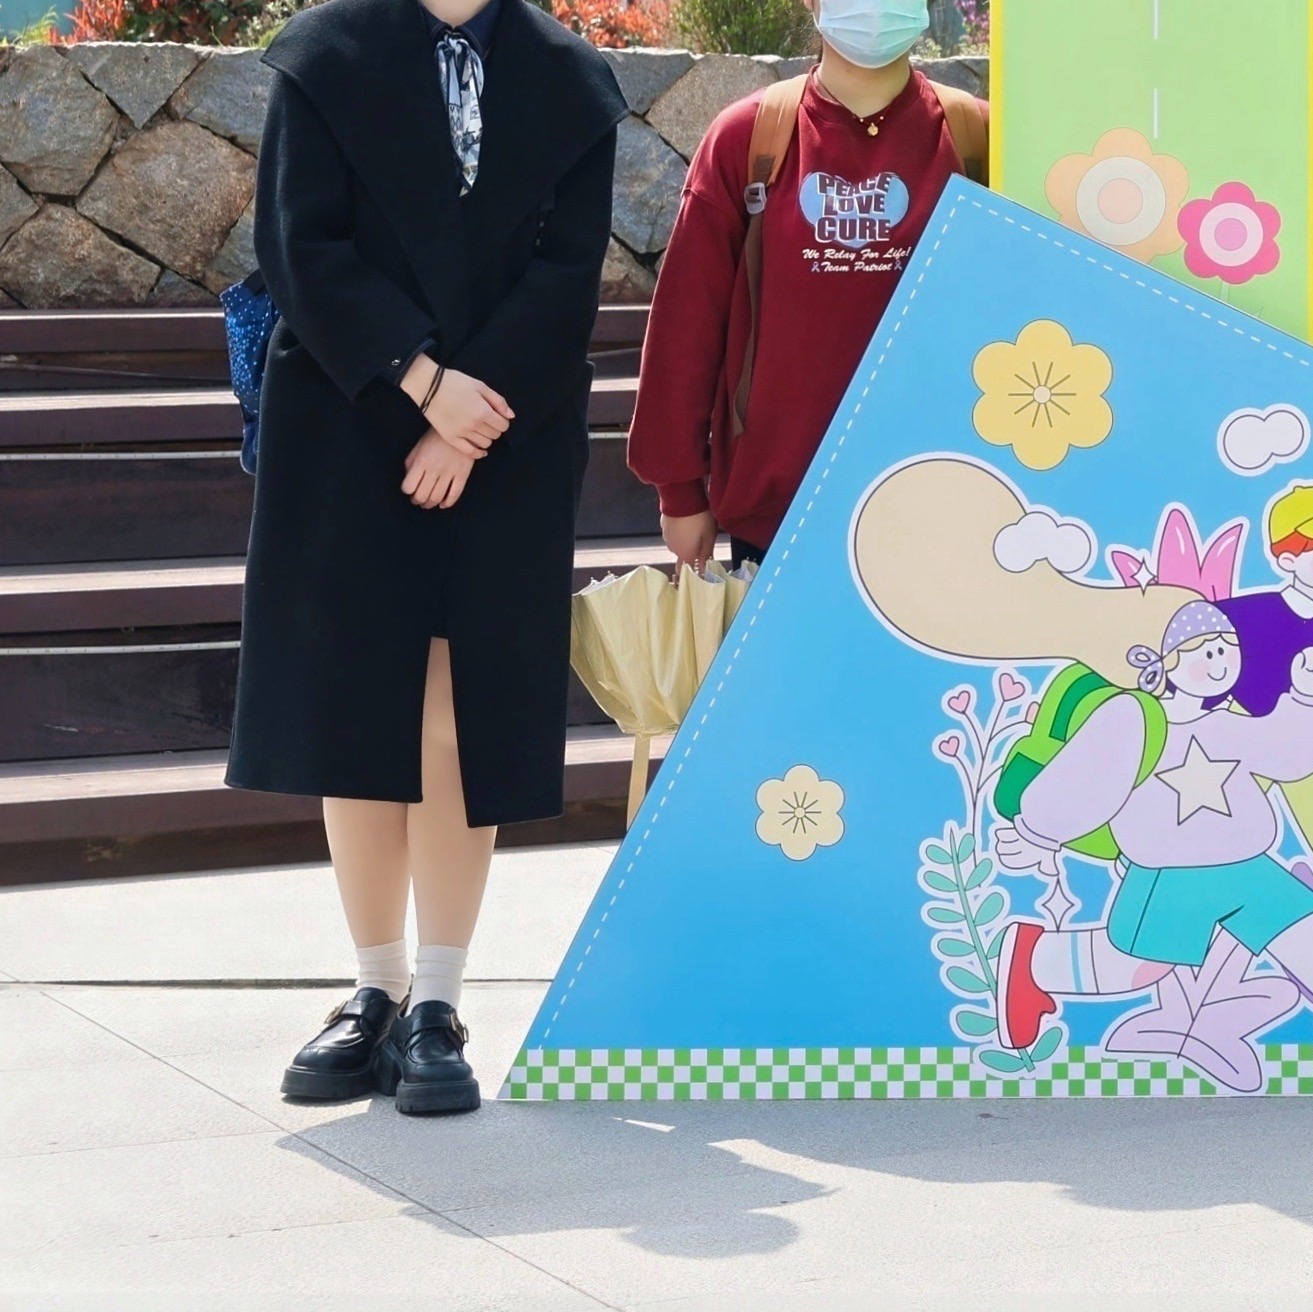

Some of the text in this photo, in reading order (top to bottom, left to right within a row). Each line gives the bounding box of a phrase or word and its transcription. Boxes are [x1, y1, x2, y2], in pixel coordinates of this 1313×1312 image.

[816, 172, 891, 199] PEACE
[822, 192, 886, 218] LOVE
[814, 216, 892, 243] CURE
[802, 246, 912, 261] We Relay For Life!
[820, 261, 894, 273] Team Patriot
